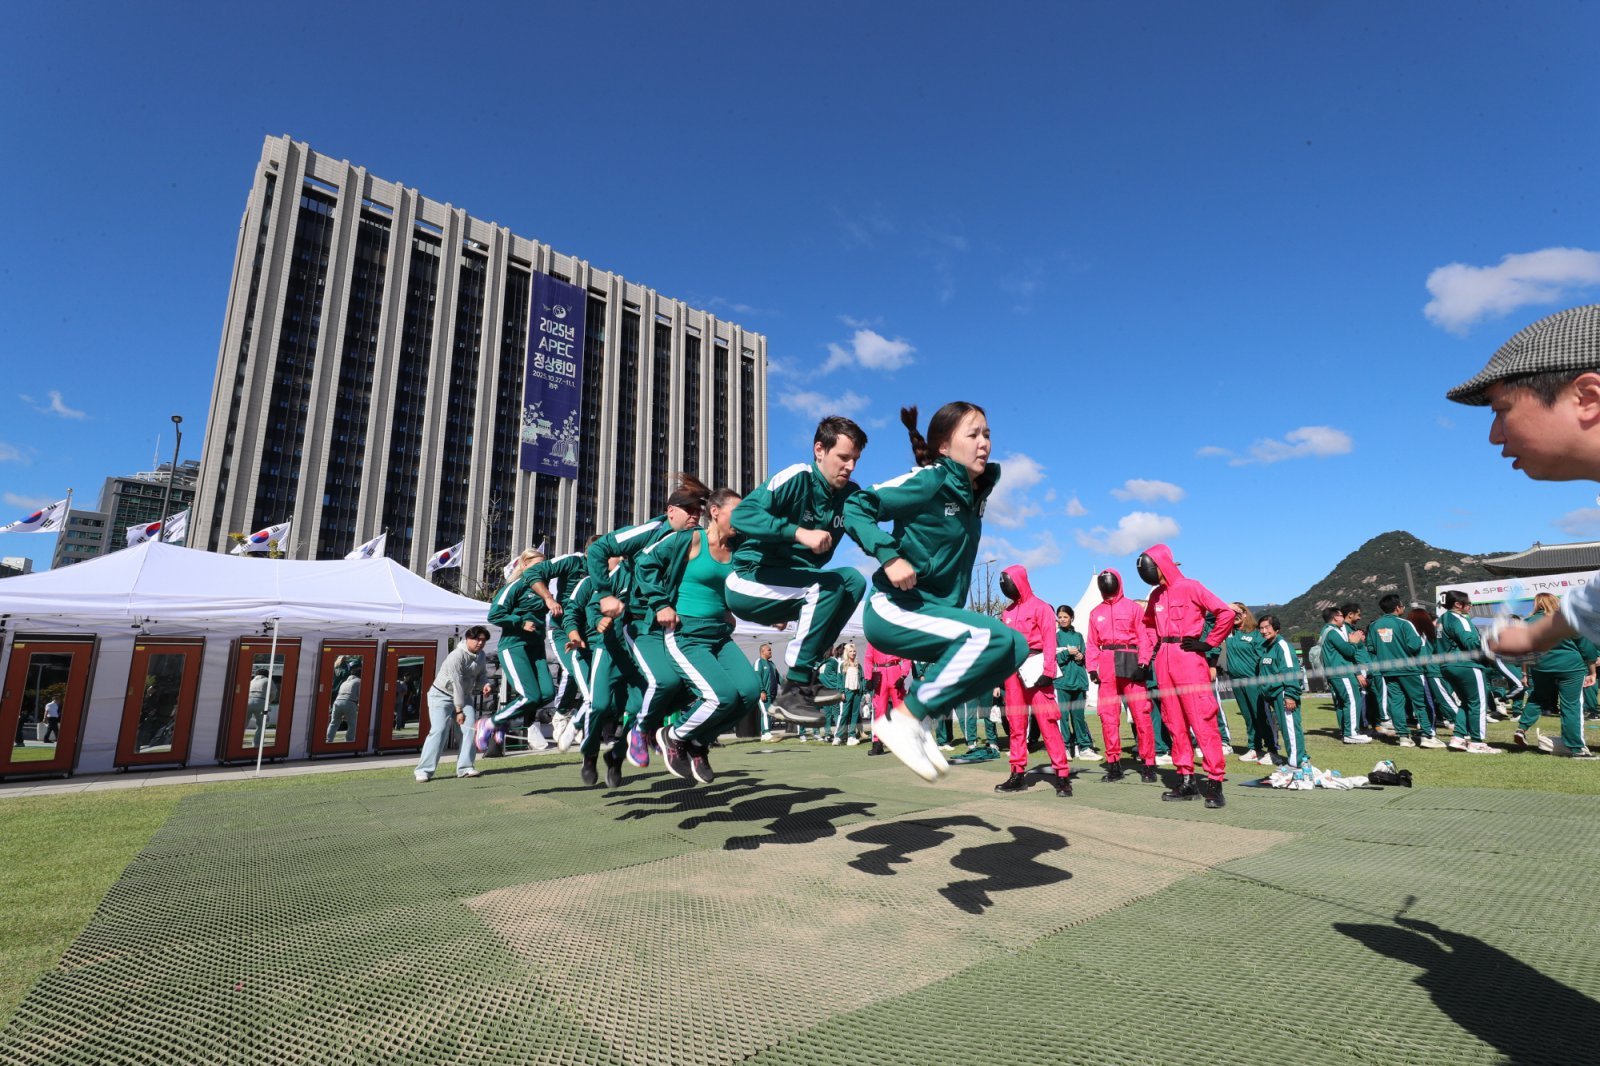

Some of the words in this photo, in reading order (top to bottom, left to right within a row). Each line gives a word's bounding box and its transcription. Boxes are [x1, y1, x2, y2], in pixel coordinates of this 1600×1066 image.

[539, 317, 575, 341] 2025년
[538, 336, 574, 358] APEC
[534, 352, 576, 379] 정상회의
[1532, 580, 1575, 591] TRAVEL
